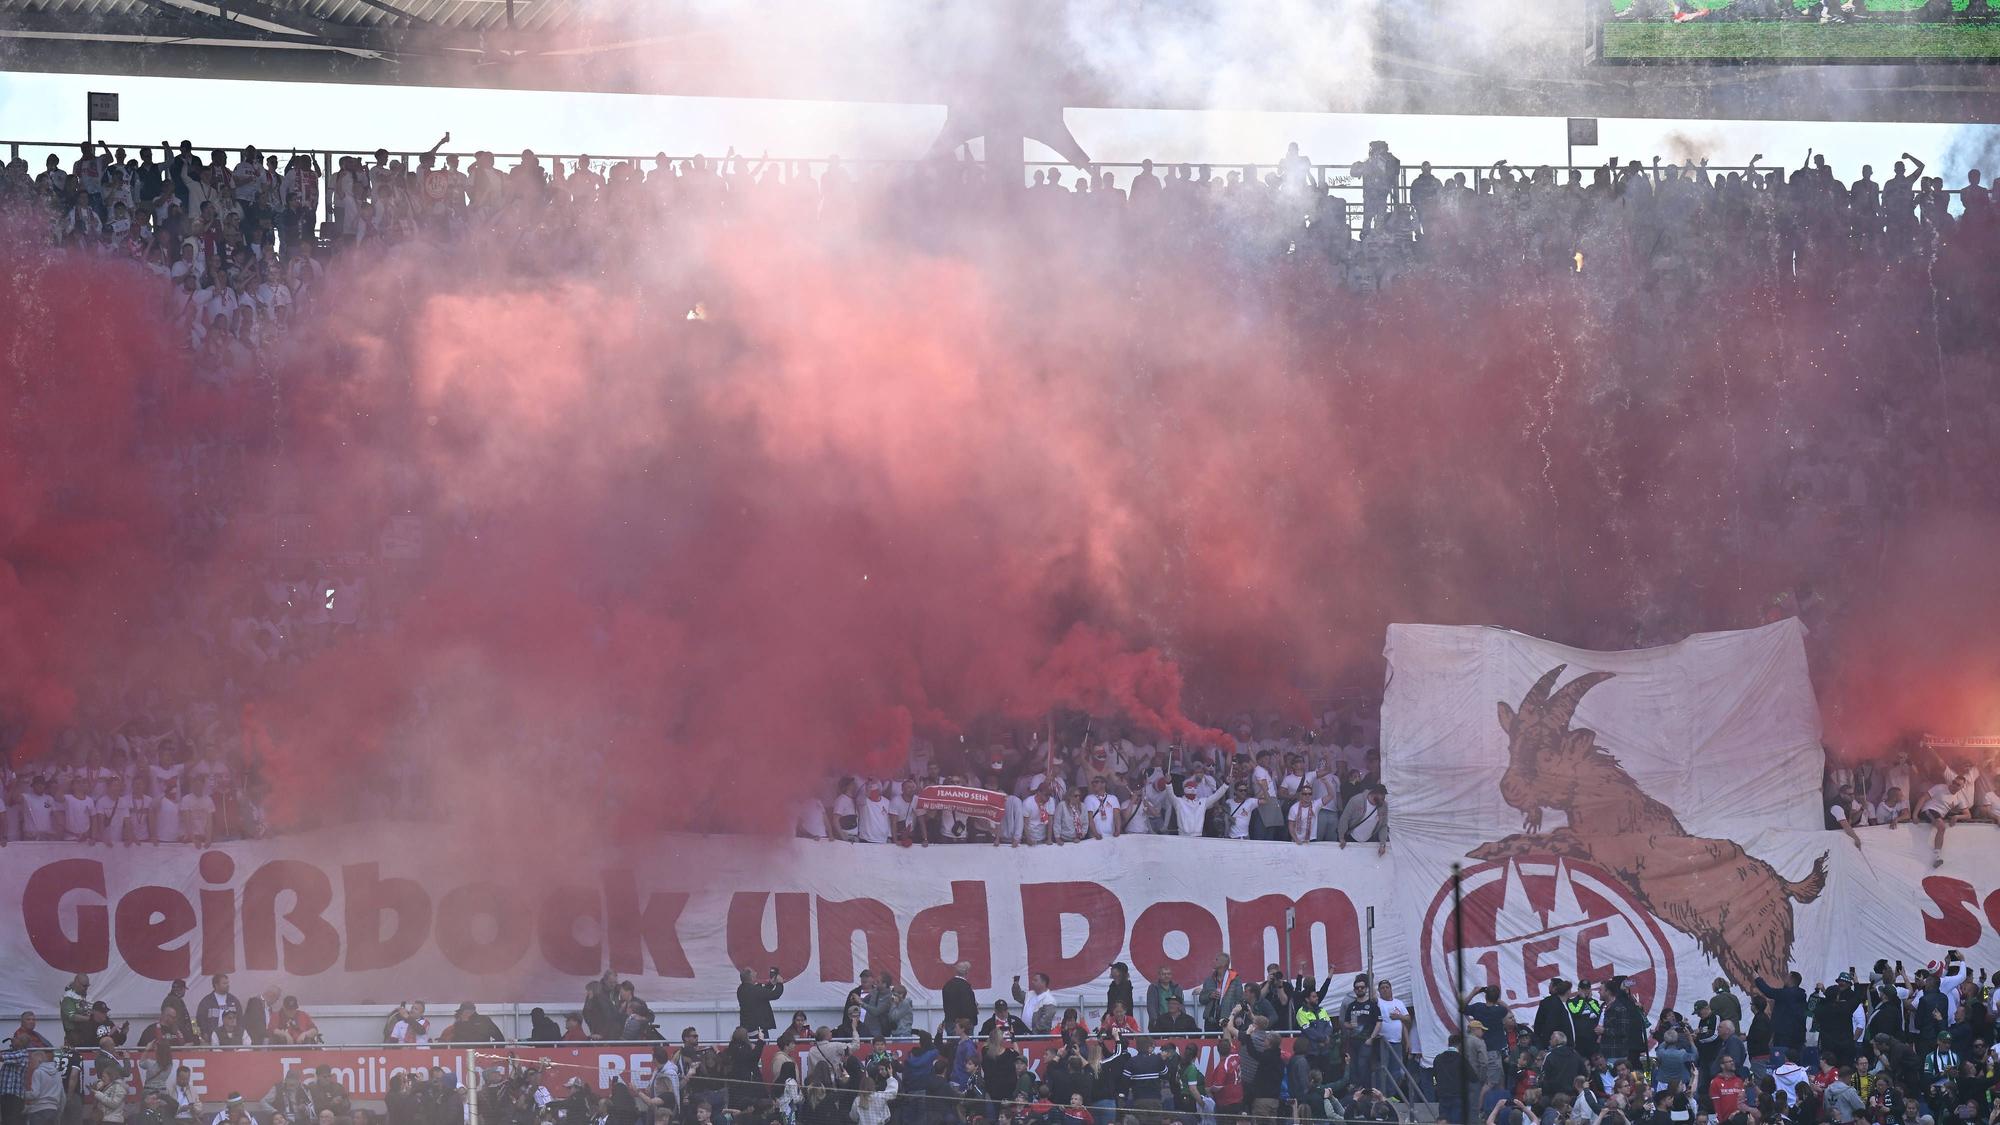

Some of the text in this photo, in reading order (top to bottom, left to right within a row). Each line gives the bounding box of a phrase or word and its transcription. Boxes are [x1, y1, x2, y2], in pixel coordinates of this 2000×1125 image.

[937, 790, 989, 801] JEMAND SEIN
[22, 850, 1362, 991] Geißbock und Dom
